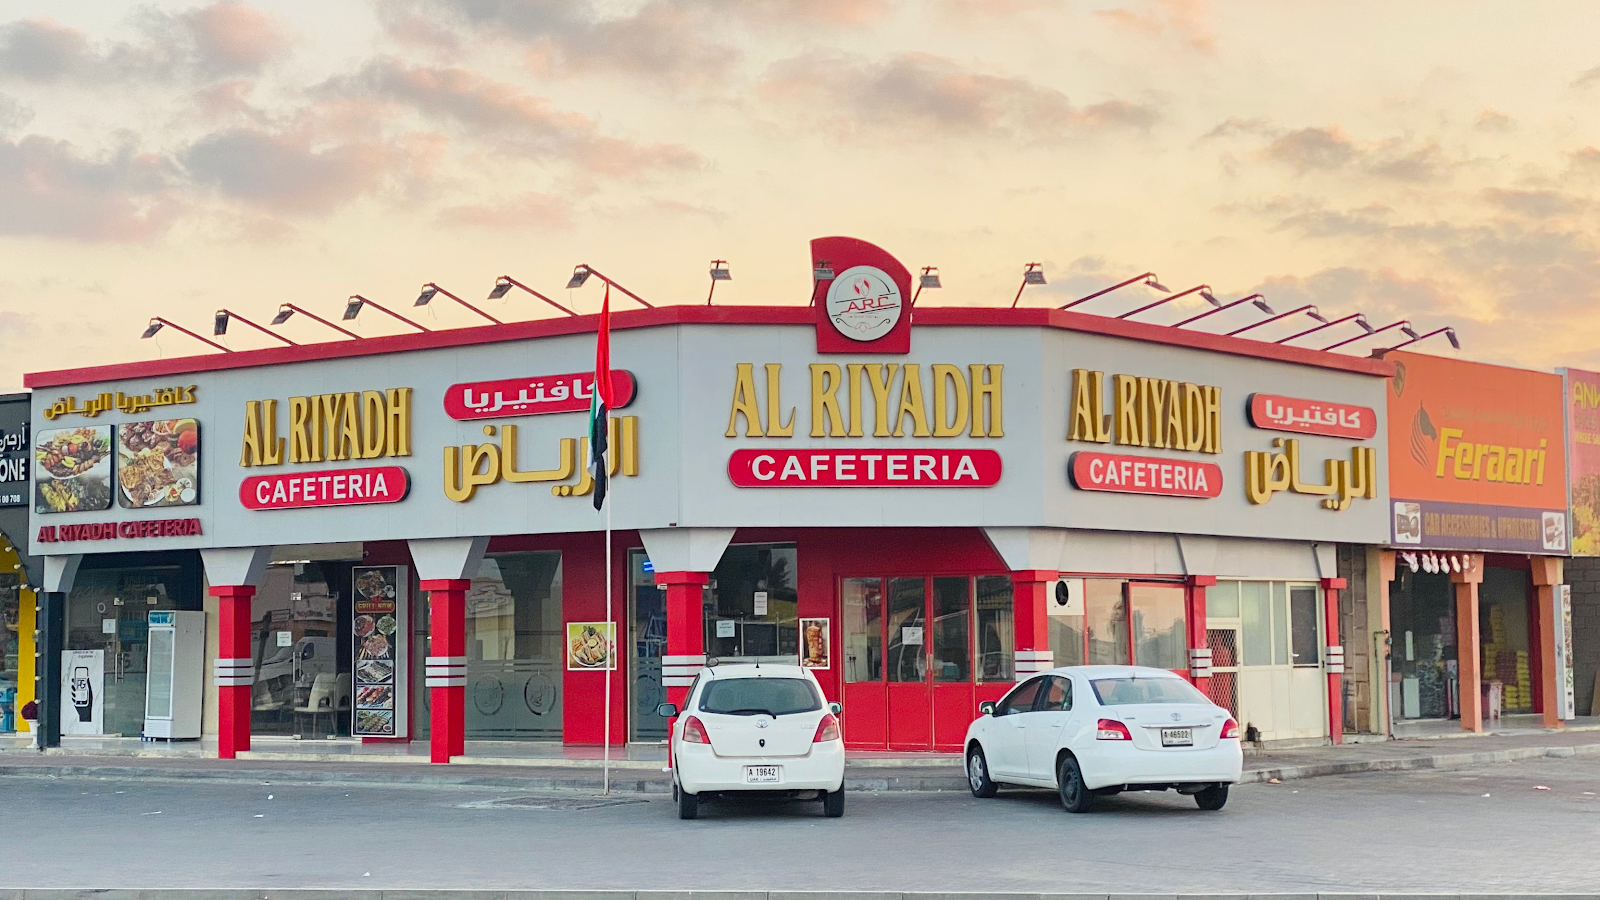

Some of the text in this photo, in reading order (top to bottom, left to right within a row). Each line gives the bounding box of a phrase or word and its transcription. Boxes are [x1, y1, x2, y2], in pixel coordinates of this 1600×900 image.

[43, 384, 198, 420] كافتيريا الرياض
[724, 363, 1005, 438] AL RIYADH
[1067, 369, 1223, 454] AL RIYADH
[1265, 400, 1361, 428] كافتيريا
[239, 387, 413, 467] AL RIYADH
[752, 455, 980, 480] CAFETERIA
[1436, 427, 1547, 486] Feraari
[256, 473, 388, 504] CAFETERIA
[1089, 459, 1208, 492] CAFETERIA
[1244, 437, 1377, 511] الرياض
[37, 518, 203, 543] AL RIYADH CAFETERIA
[756, 768, 776, 776] 19642
